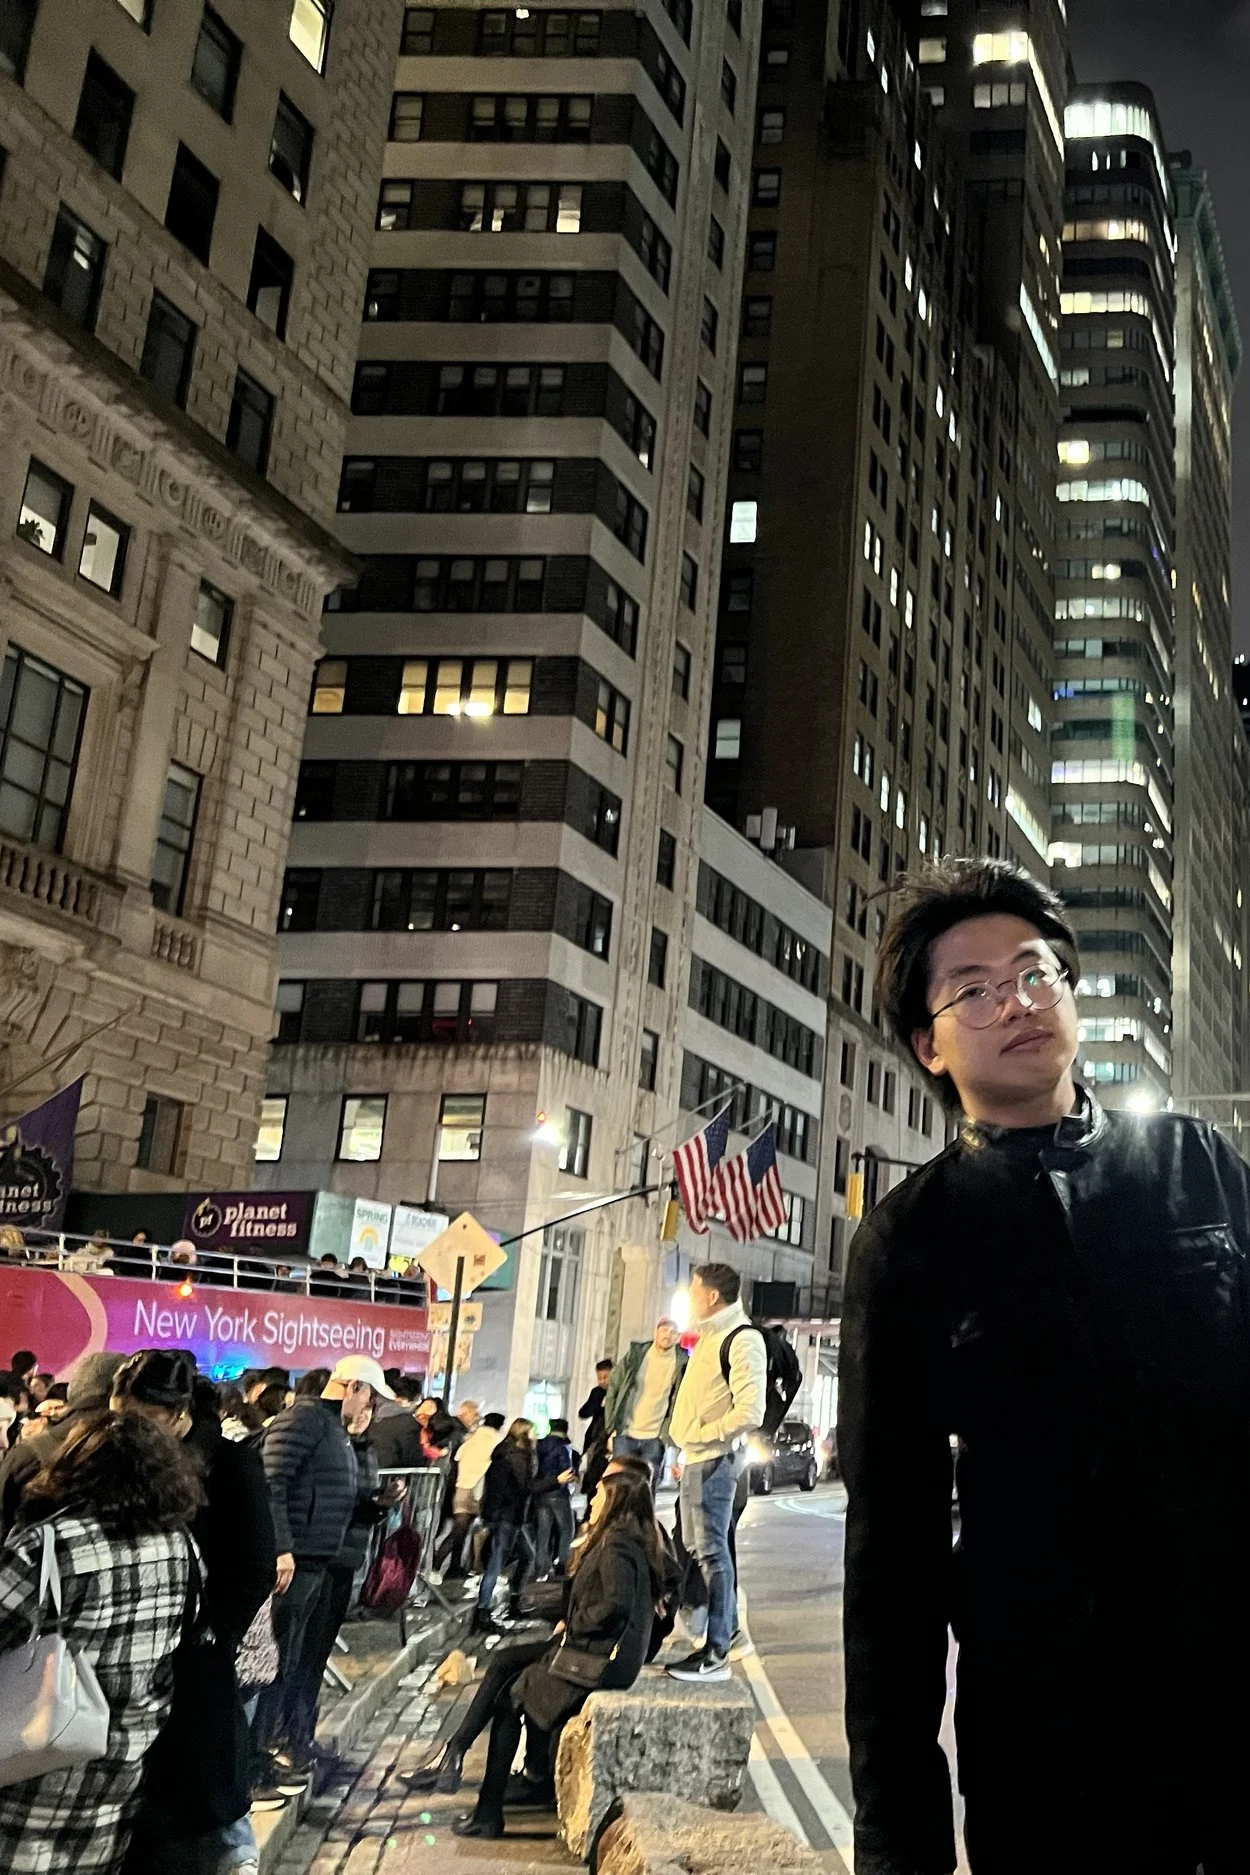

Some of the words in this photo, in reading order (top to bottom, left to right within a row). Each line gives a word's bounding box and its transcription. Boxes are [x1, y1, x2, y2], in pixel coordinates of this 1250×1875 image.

[223, 1202, 287, 1225] planet
[230, 1219, 297, 1238] fitness
[133, 1299, 198, 1339] New
[204, 1304, 258, 1344] York
[262, 1311, 386, 1358] Sightseeing
